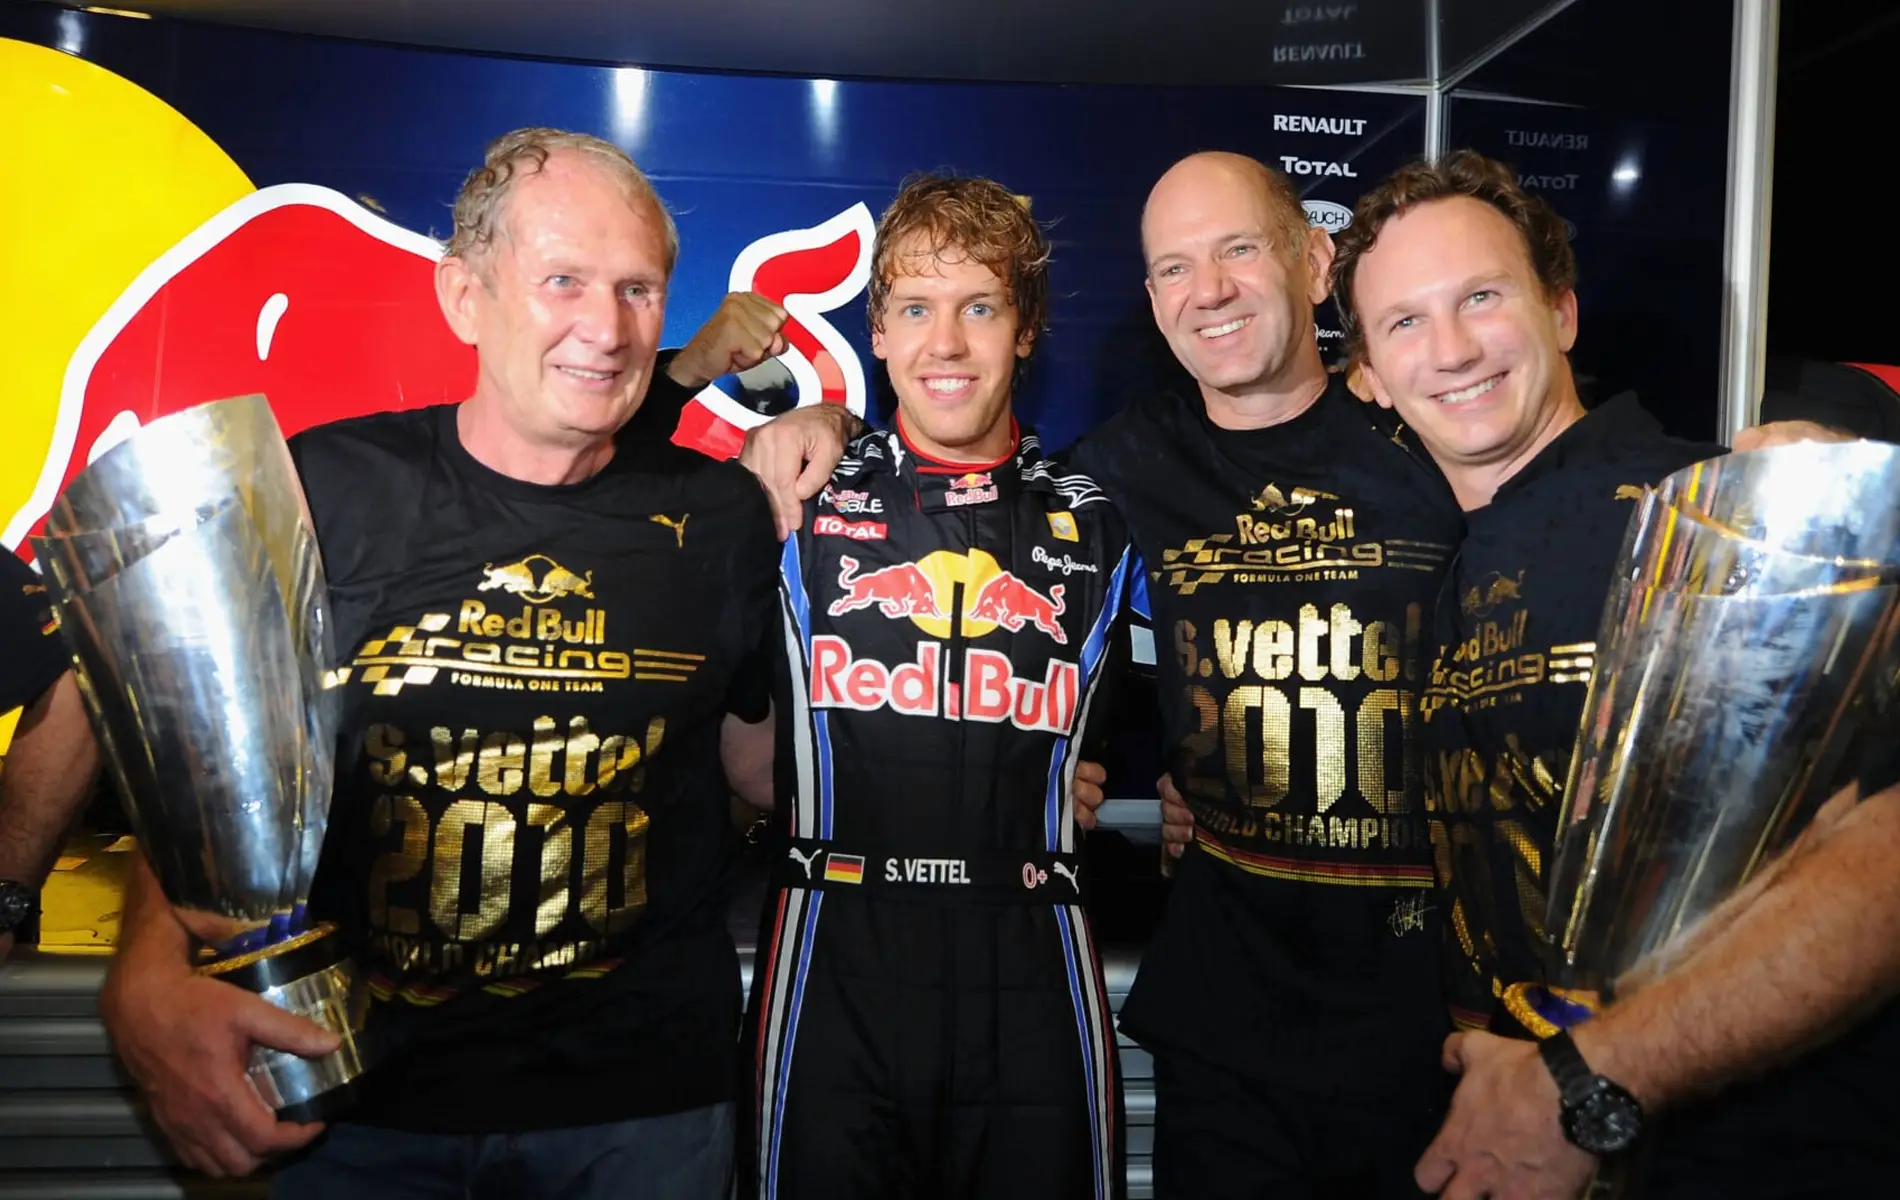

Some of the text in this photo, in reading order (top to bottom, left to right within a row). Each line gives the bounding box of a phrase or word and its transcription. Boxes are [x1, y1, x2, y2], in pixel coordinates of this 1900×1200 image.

[1273, 115, 1367, 135] RENAULT
[1280, 156, 1357, 177] TOTAL
[1306, 211, 1345, 225] AUCH
[820, 517, 883, 539] TOTAL
[1236, 507, 1355, 545] Red Bull
[1032, 546, 1098, 575] Pepe Jeans
[1213, 541, 1383, 568] racing
[1233, 569, 1359, 584] FORMULA ONE TEAM
[457, 598, 607, 645] Red Bull
[422, 636, 631, 680] racing
[450, 671, 605, 693] FORMULA ONE TEAM
[810, 634, 1080, 736] Red Bull
[368, 795, 651, 941] 2010
